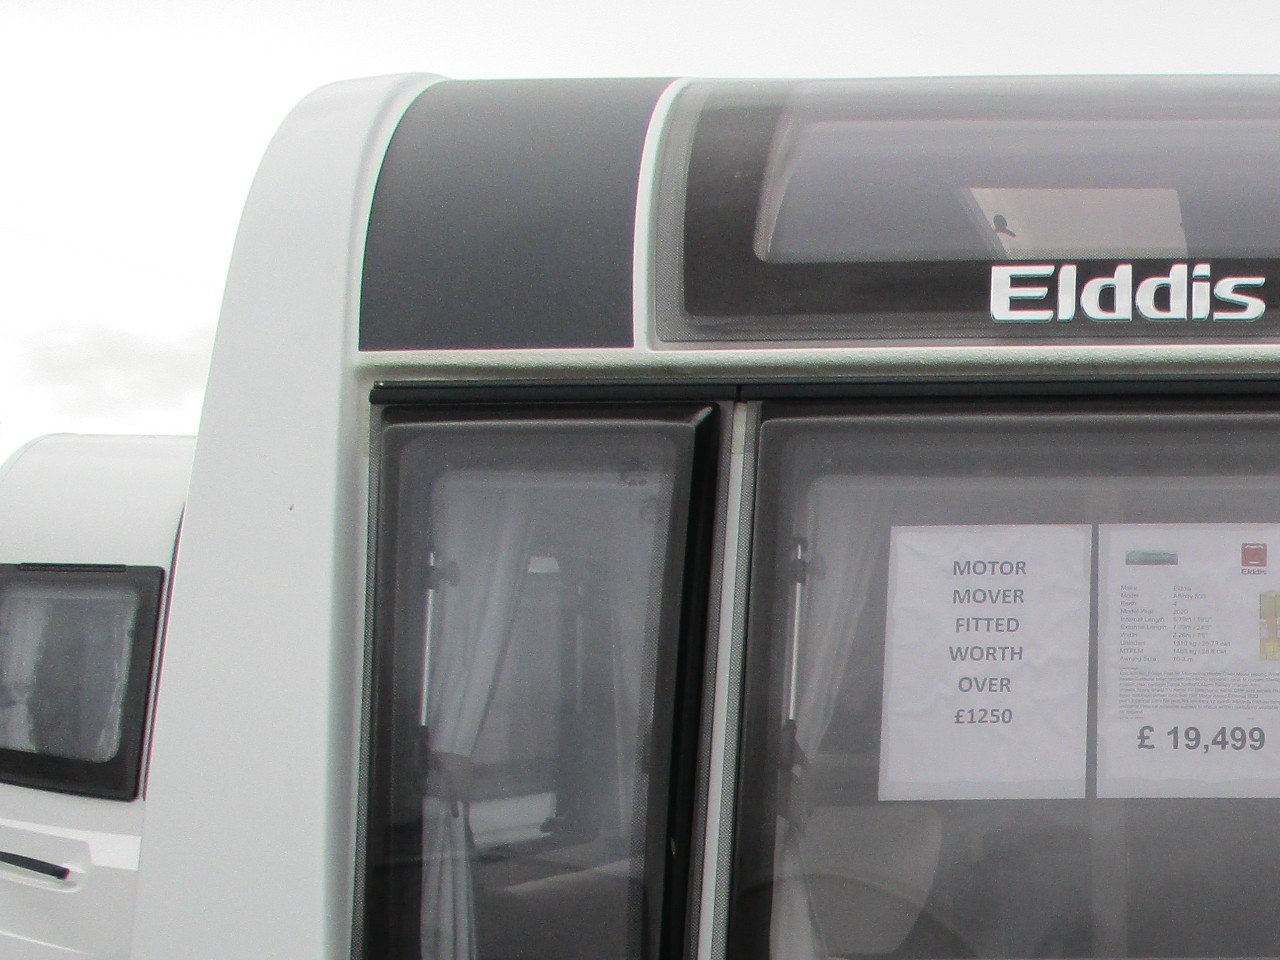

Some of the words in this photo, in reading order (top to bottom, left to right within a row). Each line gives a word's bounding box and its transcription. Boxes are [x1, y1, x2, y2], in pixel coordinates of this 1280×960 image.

[990, 263, 1266, 322] Elddis
[952, 560, 1027, 576] MOTOR
[952, 588, 1025, 605] MOVER
[955, 617, 1020, 633] FITTED
[949, 645, 1024, 662] WORTH
[957, 676, 1012, 693] OVER
[954, 708, 1013, 725] £1250
[1137, 726, 1155, 749] £
[1167, 726, 1266, 754] 19,499
